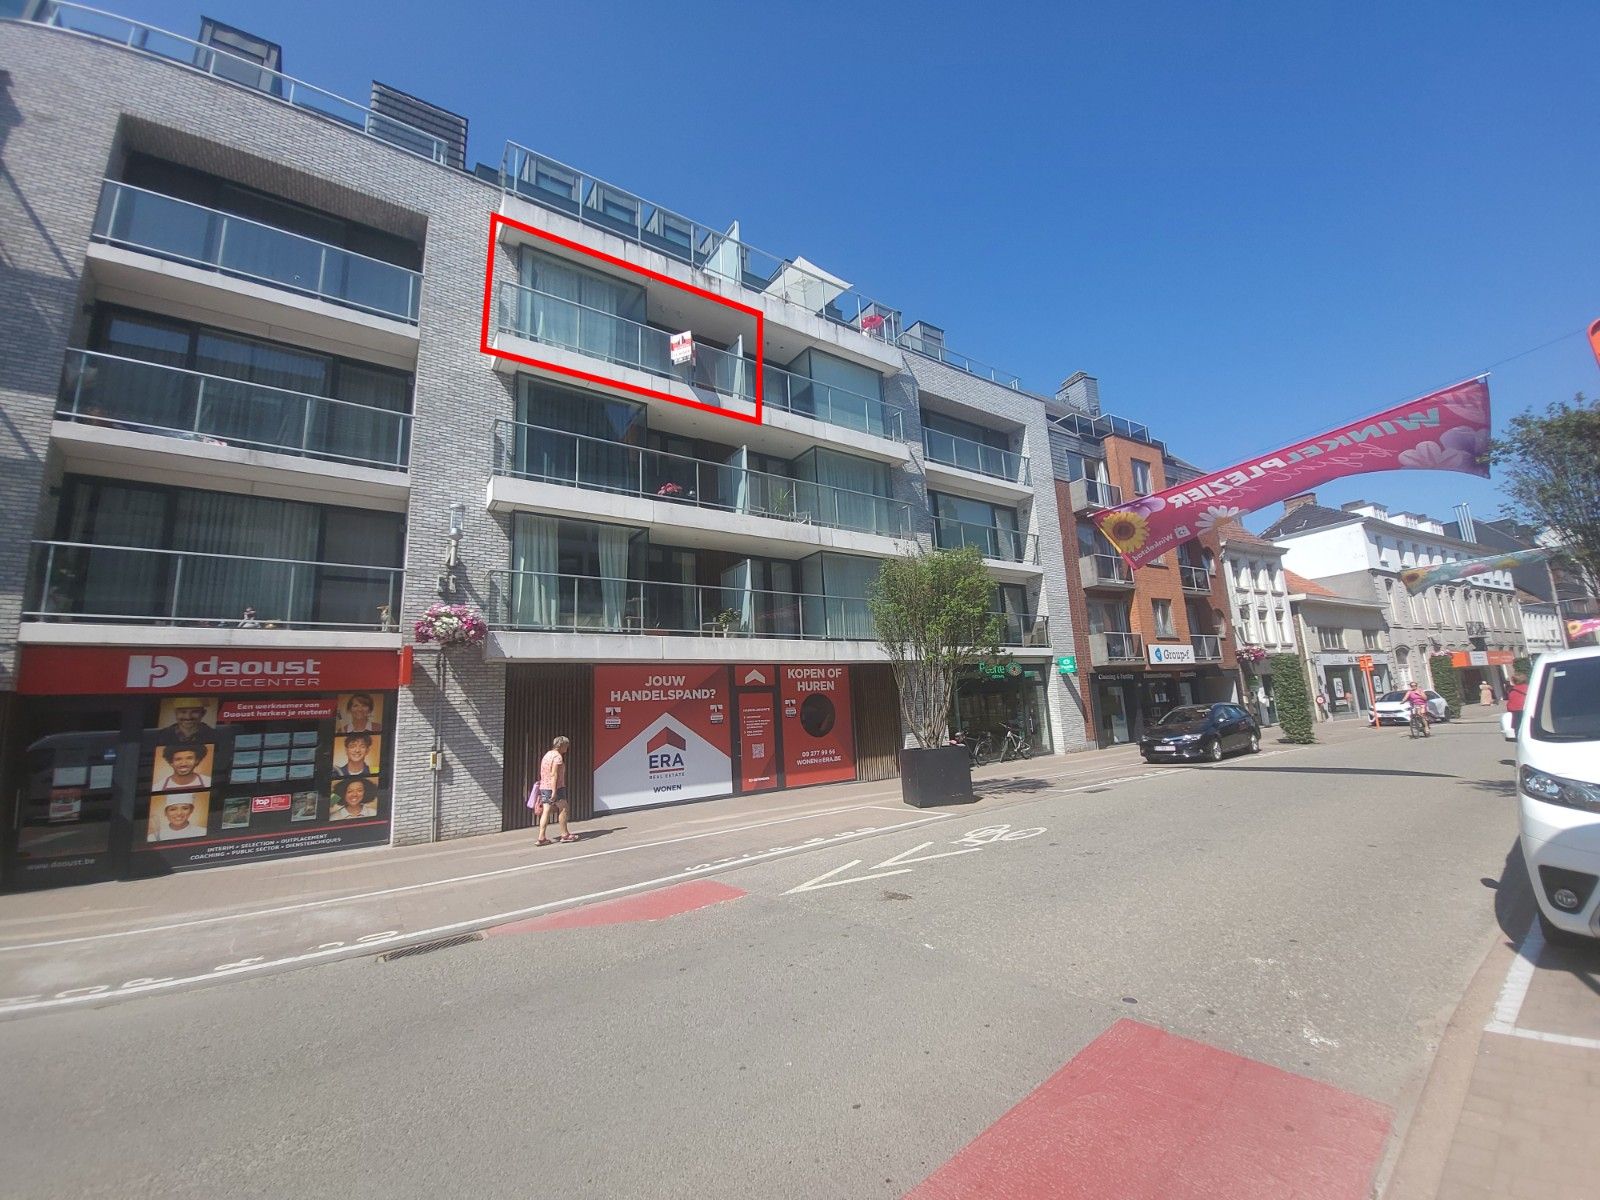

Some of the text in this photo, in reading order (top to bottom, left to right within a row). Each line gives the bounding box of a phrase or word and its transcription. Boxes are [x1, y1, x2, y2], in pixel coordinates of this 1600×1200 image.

[194, 655, 321, 675] daoust
[787, 668, 842, 679] KOPEN OF
[193, 678, 321, 688] JOBCENTER
[644, 675, 686, 687] JOUW
[797, 680, 835, 692] HUREN
[610, 688, 717, 702] HANDELSPAND?
[255, 702, 303, 710] werknemer
[649, 753, 684, 769] ERA
[653, 784, 682, 793] WONEN
[207, 833, 328, 853] INTERIM SELECTION OUTPLACEMENT
[190, 851, 225, 861] COACHING
[231, 848, 254, 856] PUBLIC
[255, 845, 280, 853] SECTOR
